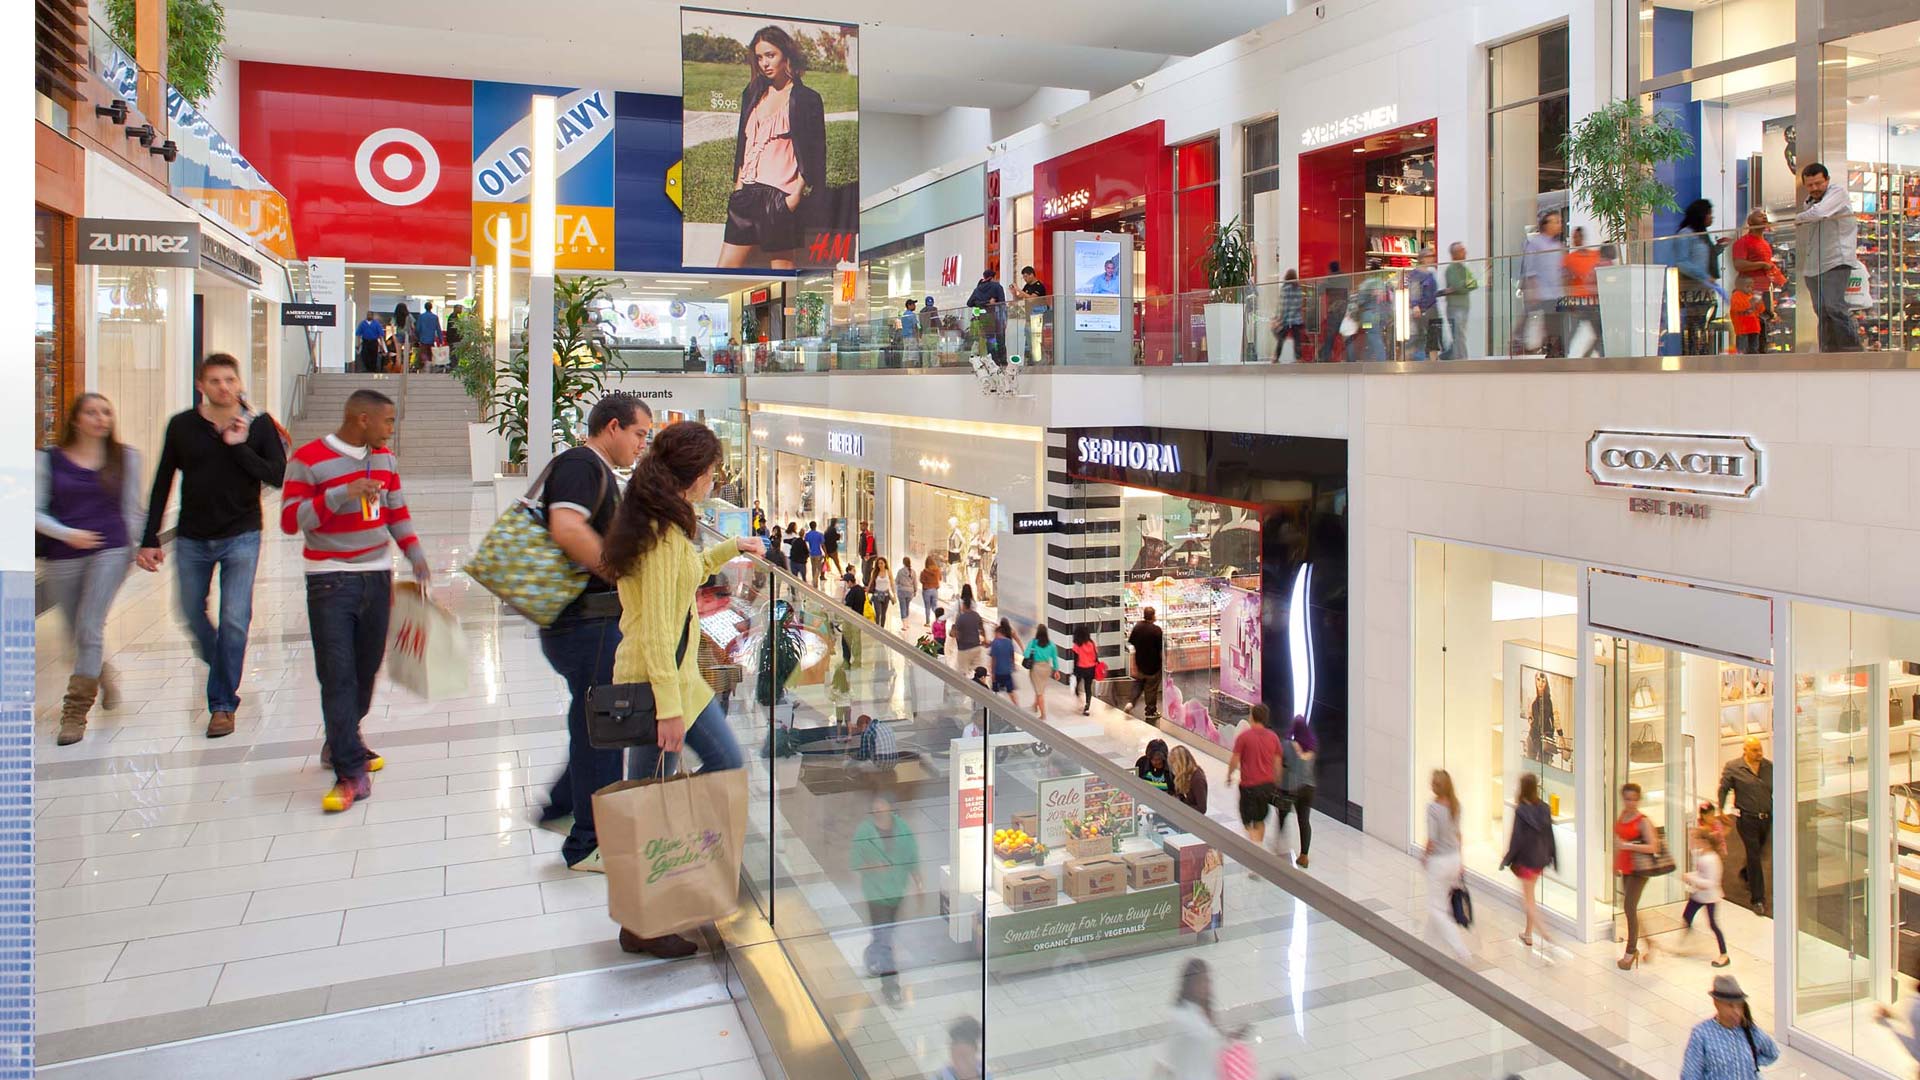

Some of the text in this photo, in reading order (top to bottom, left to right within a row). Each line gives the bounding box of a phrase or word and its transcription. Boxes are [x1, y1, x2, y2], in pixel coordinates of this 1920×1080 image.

[710, 90, 724, 100] Top
[710, 98, 738, 110] $9.95
[477, 91, 610, 196] OLD AVY
[1042, 188, 1090, 217] EXPRESS
[88, 232, 190, 253] zumiez
[499, 211, 599, 246] UTA
[614, 389, 673, 399] Restaurants
[1077, 436, 1179, 473] SEPHORA
[1600, 448, 1744, 477] COACH
[1019, 519, 1053, 528] SEPHORA
[1045, 787, 1080, 808] Sale
[1003, 901, 1172, 944] Smart Eating For Your Busy Life
[1033, 938, 1069, 952] ORGANIC
[1070, 933, 1095, 945] FRUITS
[1104, 924, 1146, 938] VEGETABLES
